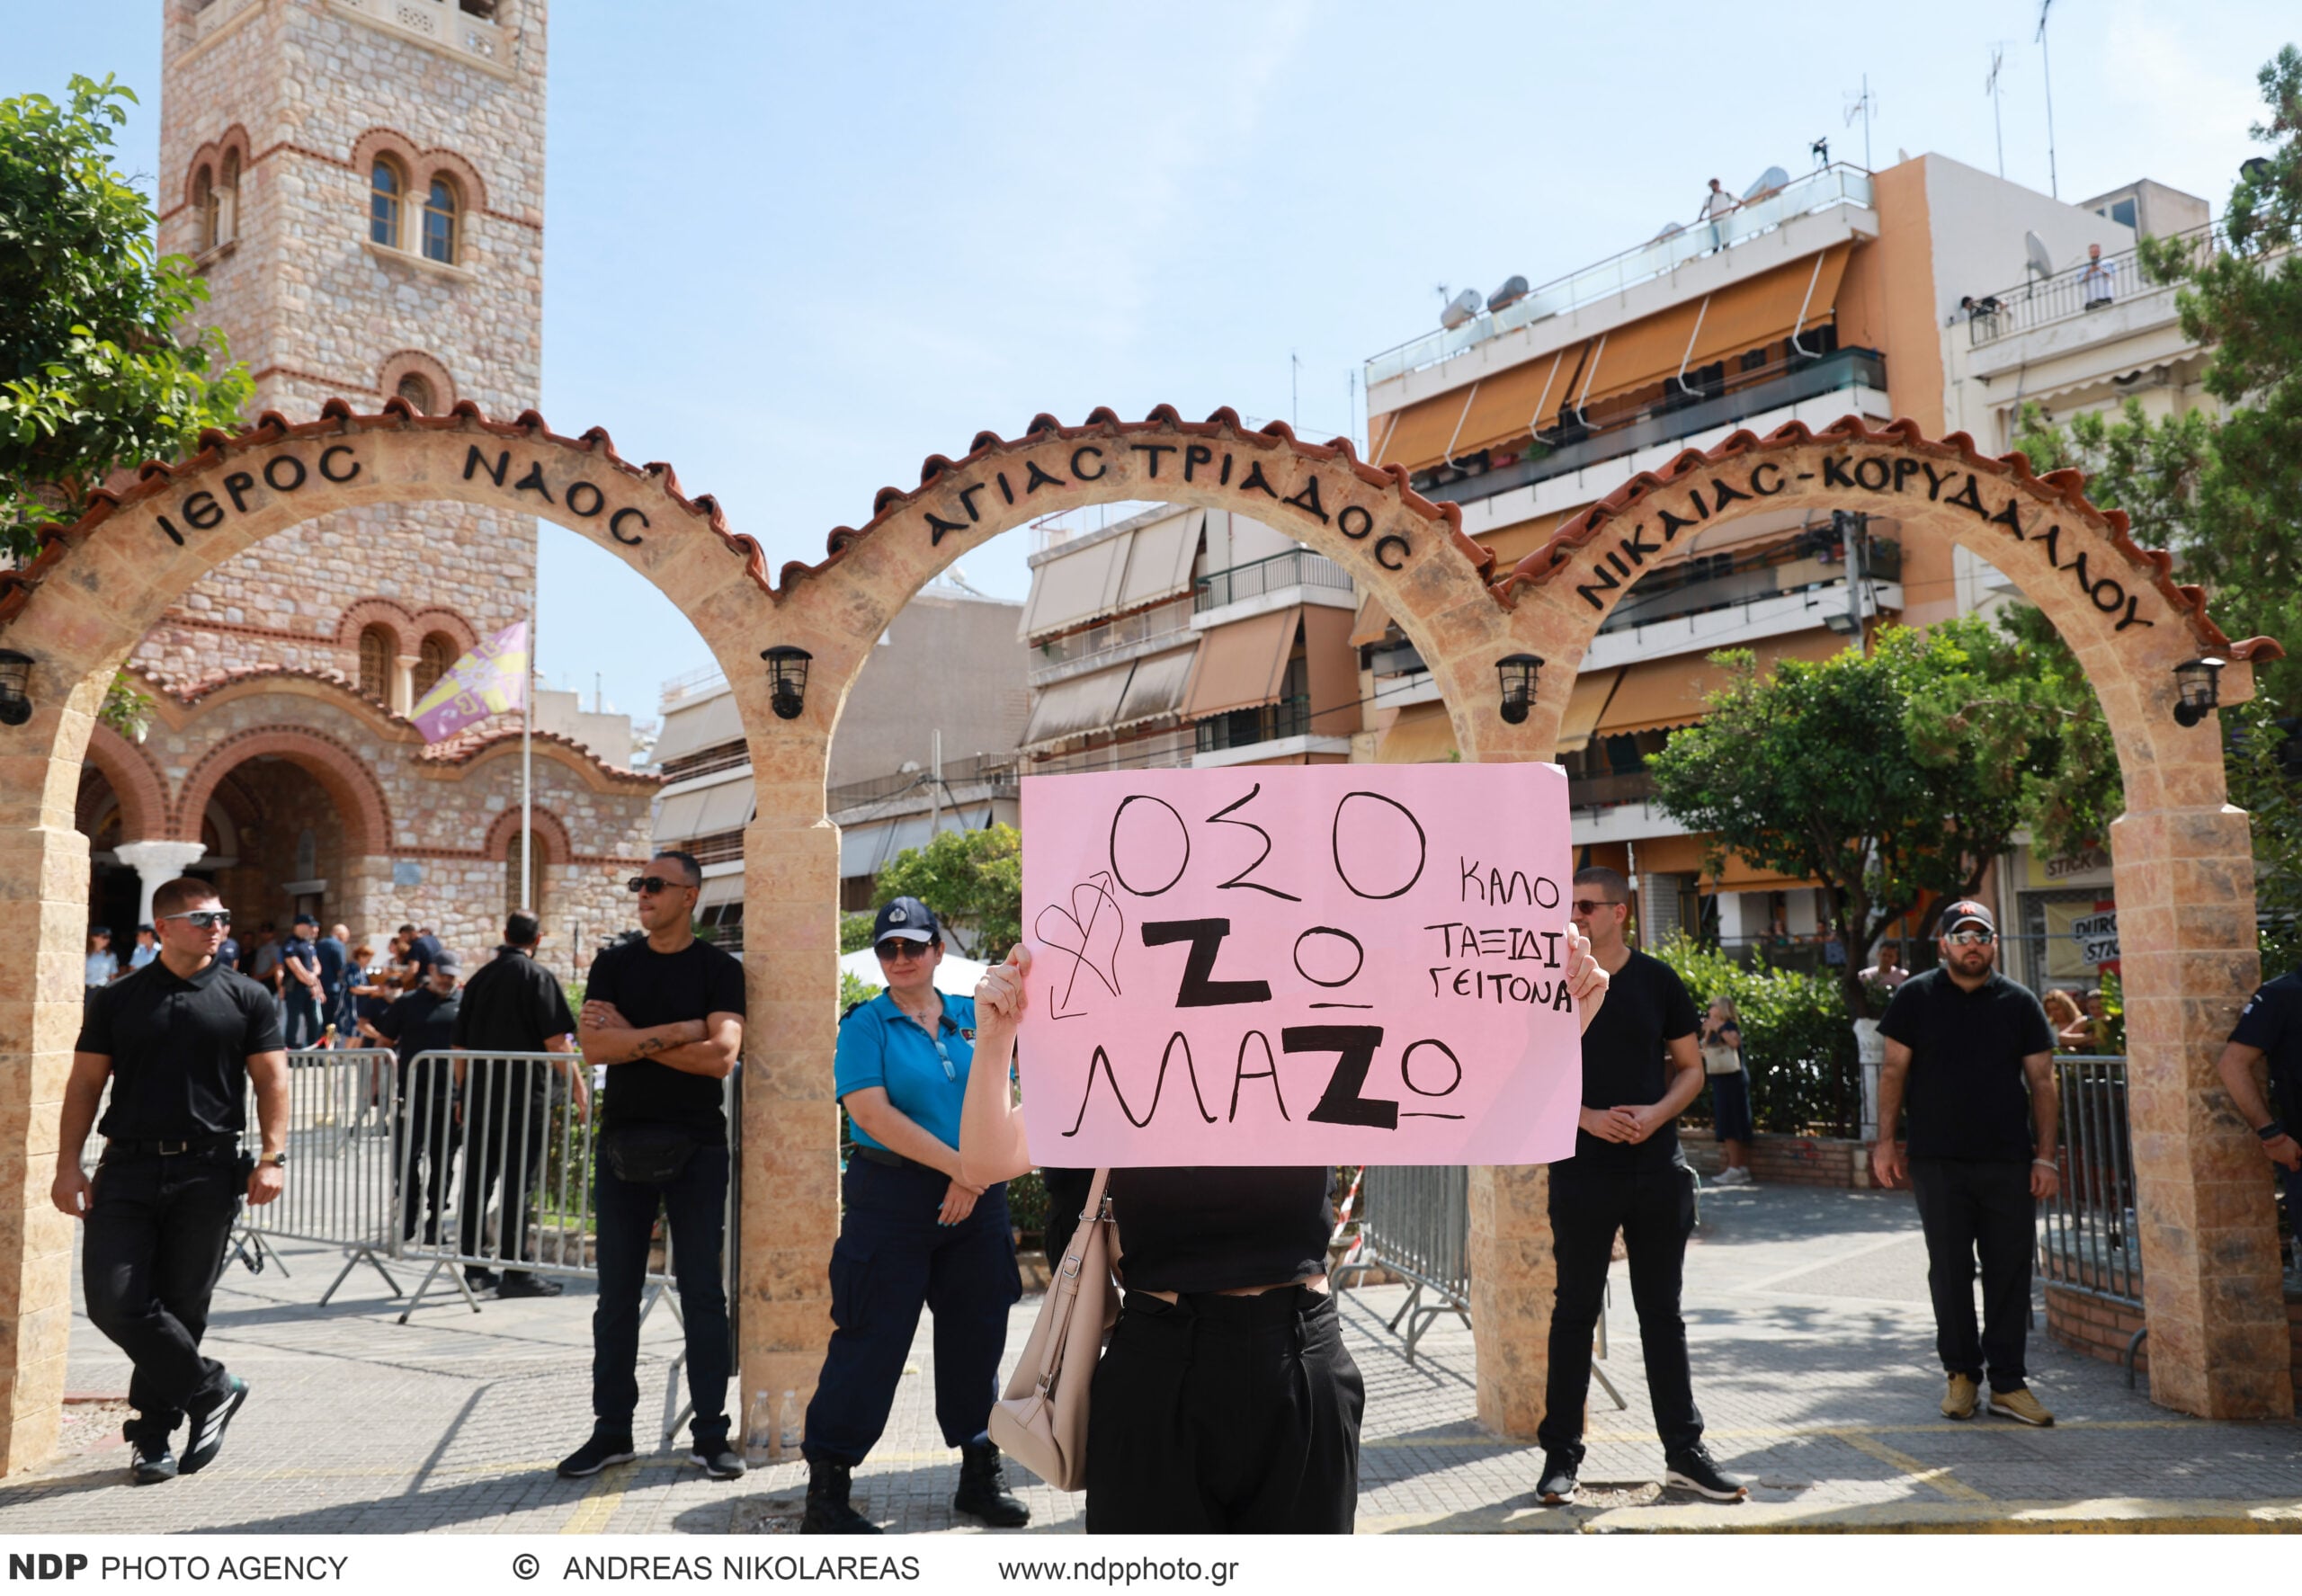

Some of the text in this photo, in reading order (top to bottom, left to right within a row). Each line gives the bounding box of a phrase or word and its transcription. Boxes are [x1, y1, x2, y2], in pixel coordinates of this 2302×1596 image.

[1110, 783, 1426, 902] ΟΣΟ
[1460, 856, 1559, 909] ΚΑΛΟ
[1423, 923, 1564, 968] ΤΑΞΙΔΙ
[1429, 967, 1572, 1012] ΓΕΙΤΟΝΑ
